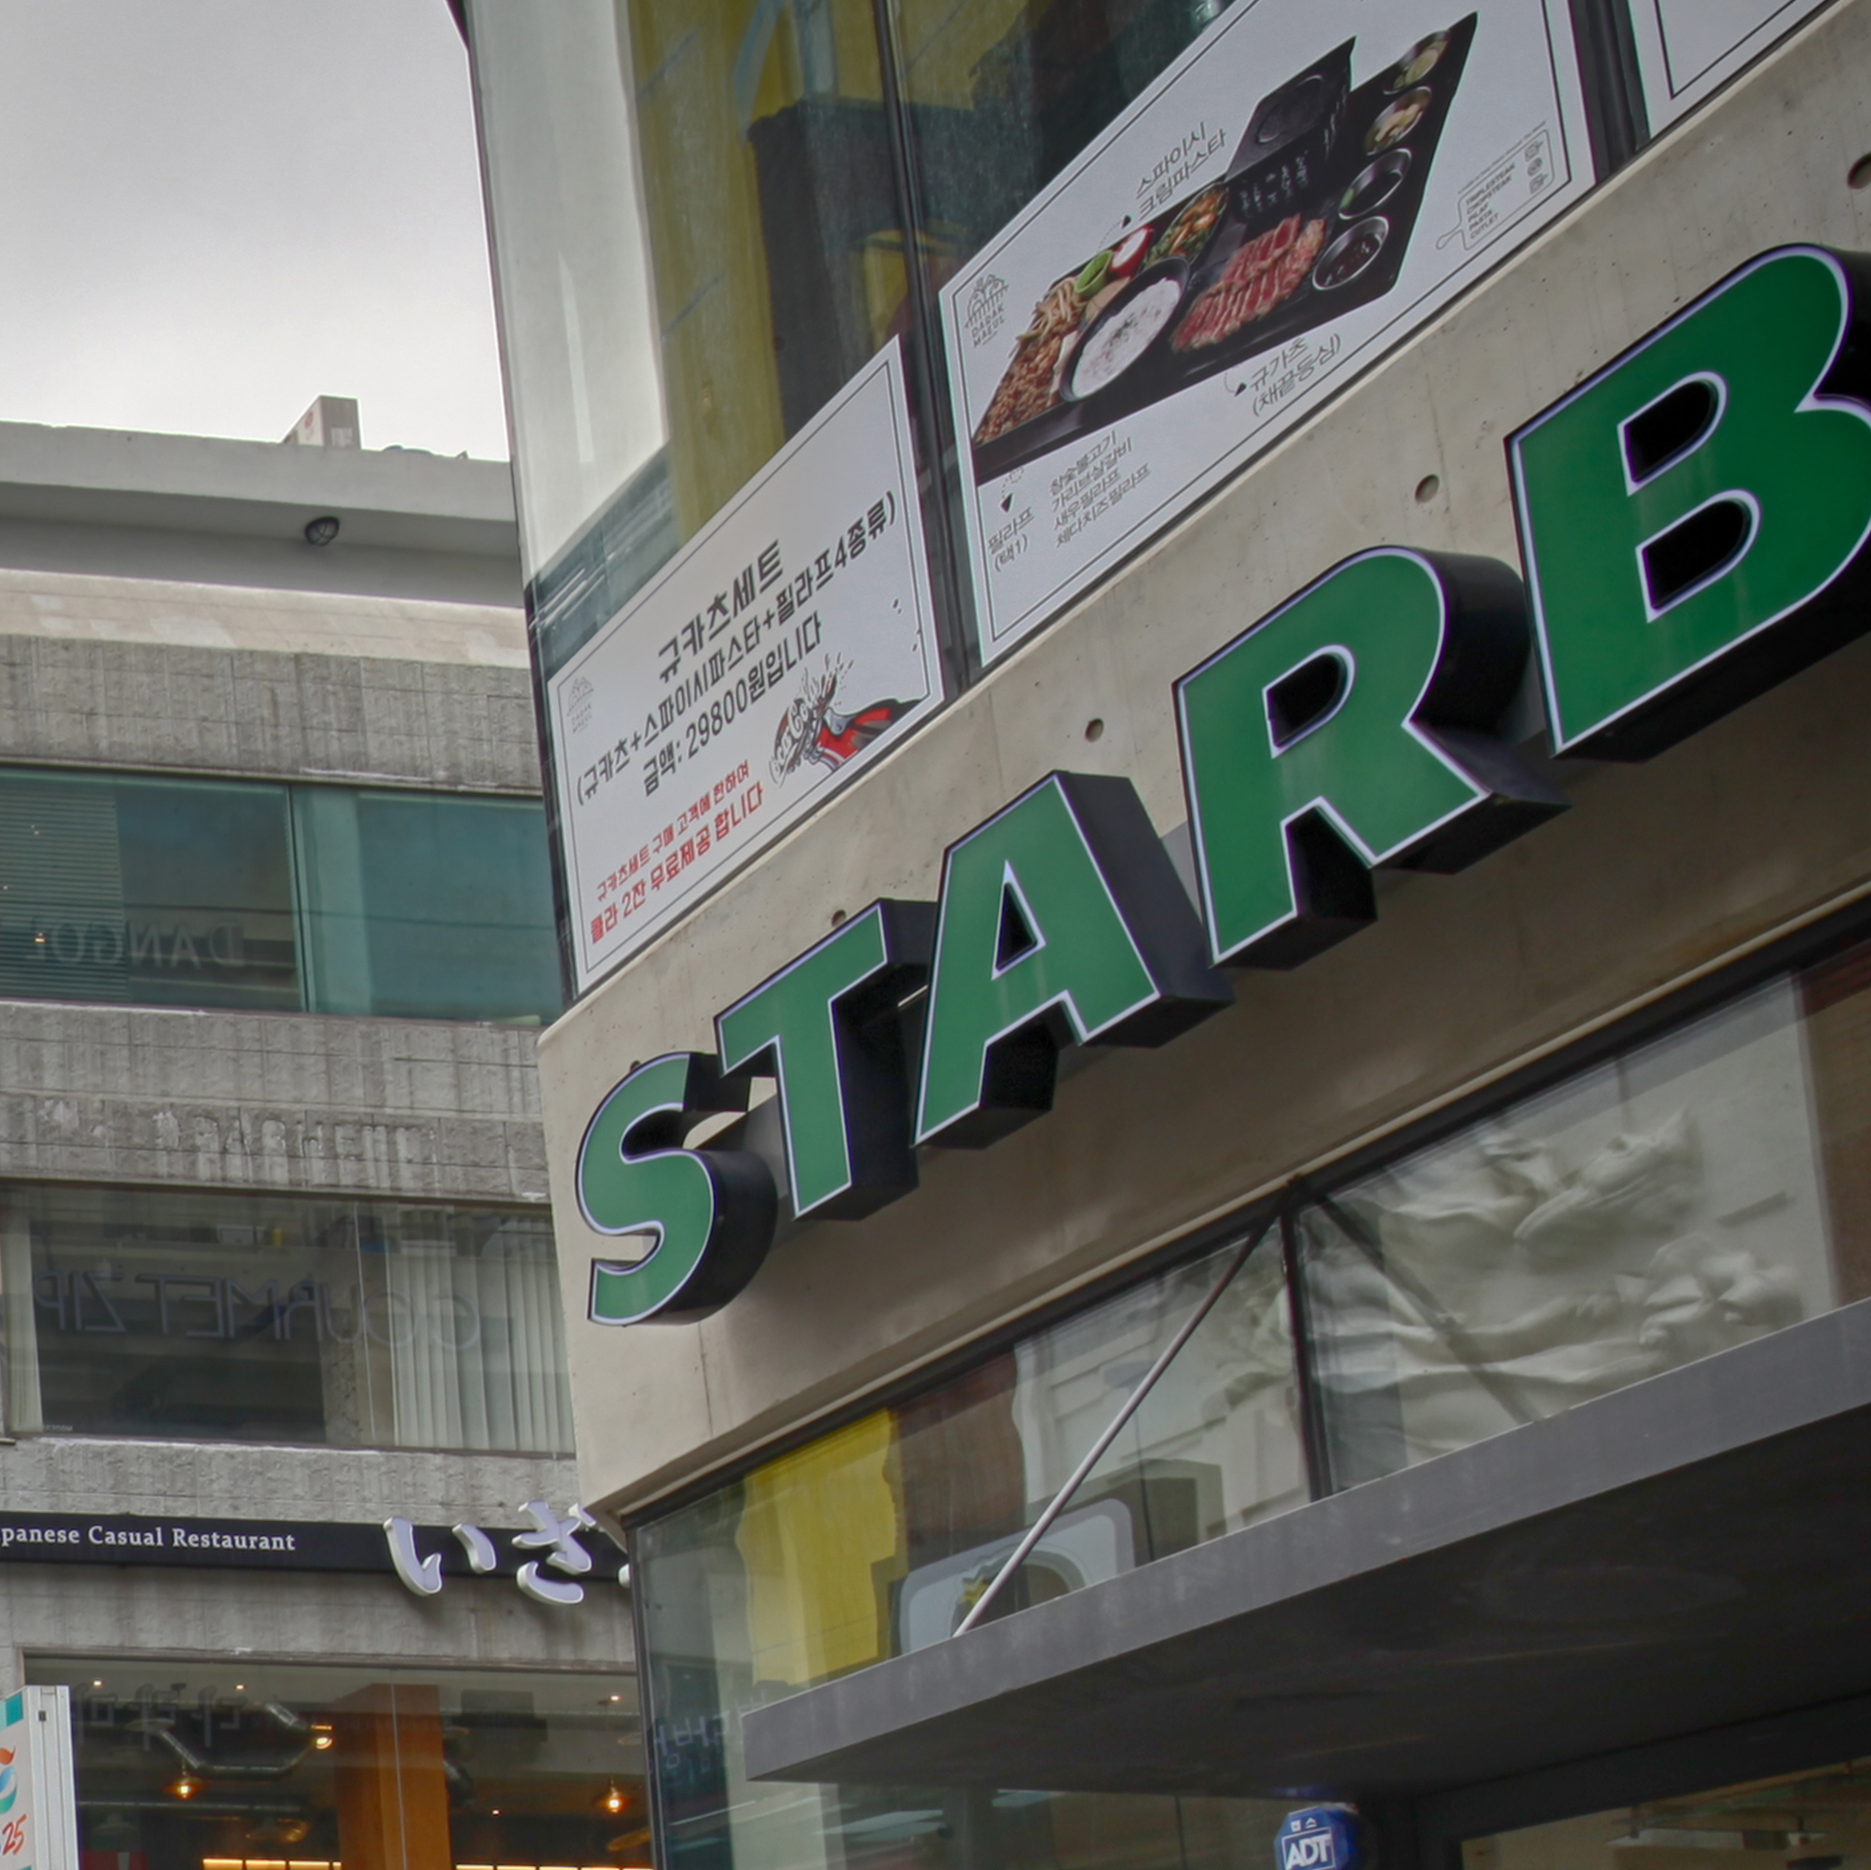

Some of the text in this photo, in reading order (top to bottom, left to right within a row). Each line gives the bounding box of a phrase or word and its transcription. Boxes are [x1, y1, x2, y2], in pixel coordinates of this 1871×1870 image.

[1135, 121, 1207, 200] 스파이시
[1138, 128, 1228, 221] 크림파스타
[971, 303, 1005, 339] DARAK
[972, 317, 1005, 348] MAEUL
[1252, 333, 1342, 418] (채끝등심)
[987, 506, 1035, 556] 필라프
[1053, 467, 1123, 531] 새우필라프
[1055, 463, 1153, 549] 체다치즈필라프
[994, 533, 1029, 573] (택1)
[657, 540, 783, 684] 규카츠세트
[643, 611, 823, 797] 금액: 29800원입니다
[576, 243, 1871, 1327] STARB
[597, 842, 651, 902] 규카츠세트
[652, 822, 674, 853] 구매
[622, 876, 647, 916] 2잔
[650, 829, 711, 892] 무료제공
[714, 782, 764, 834] 합니다
[87, 1522, 164, 1548] Casual
[171, 1525, 297, 1552] Restaurant
[383, 1500, 631, 1606] いざ
[1285, 1834, 1333, 1870] ADT
